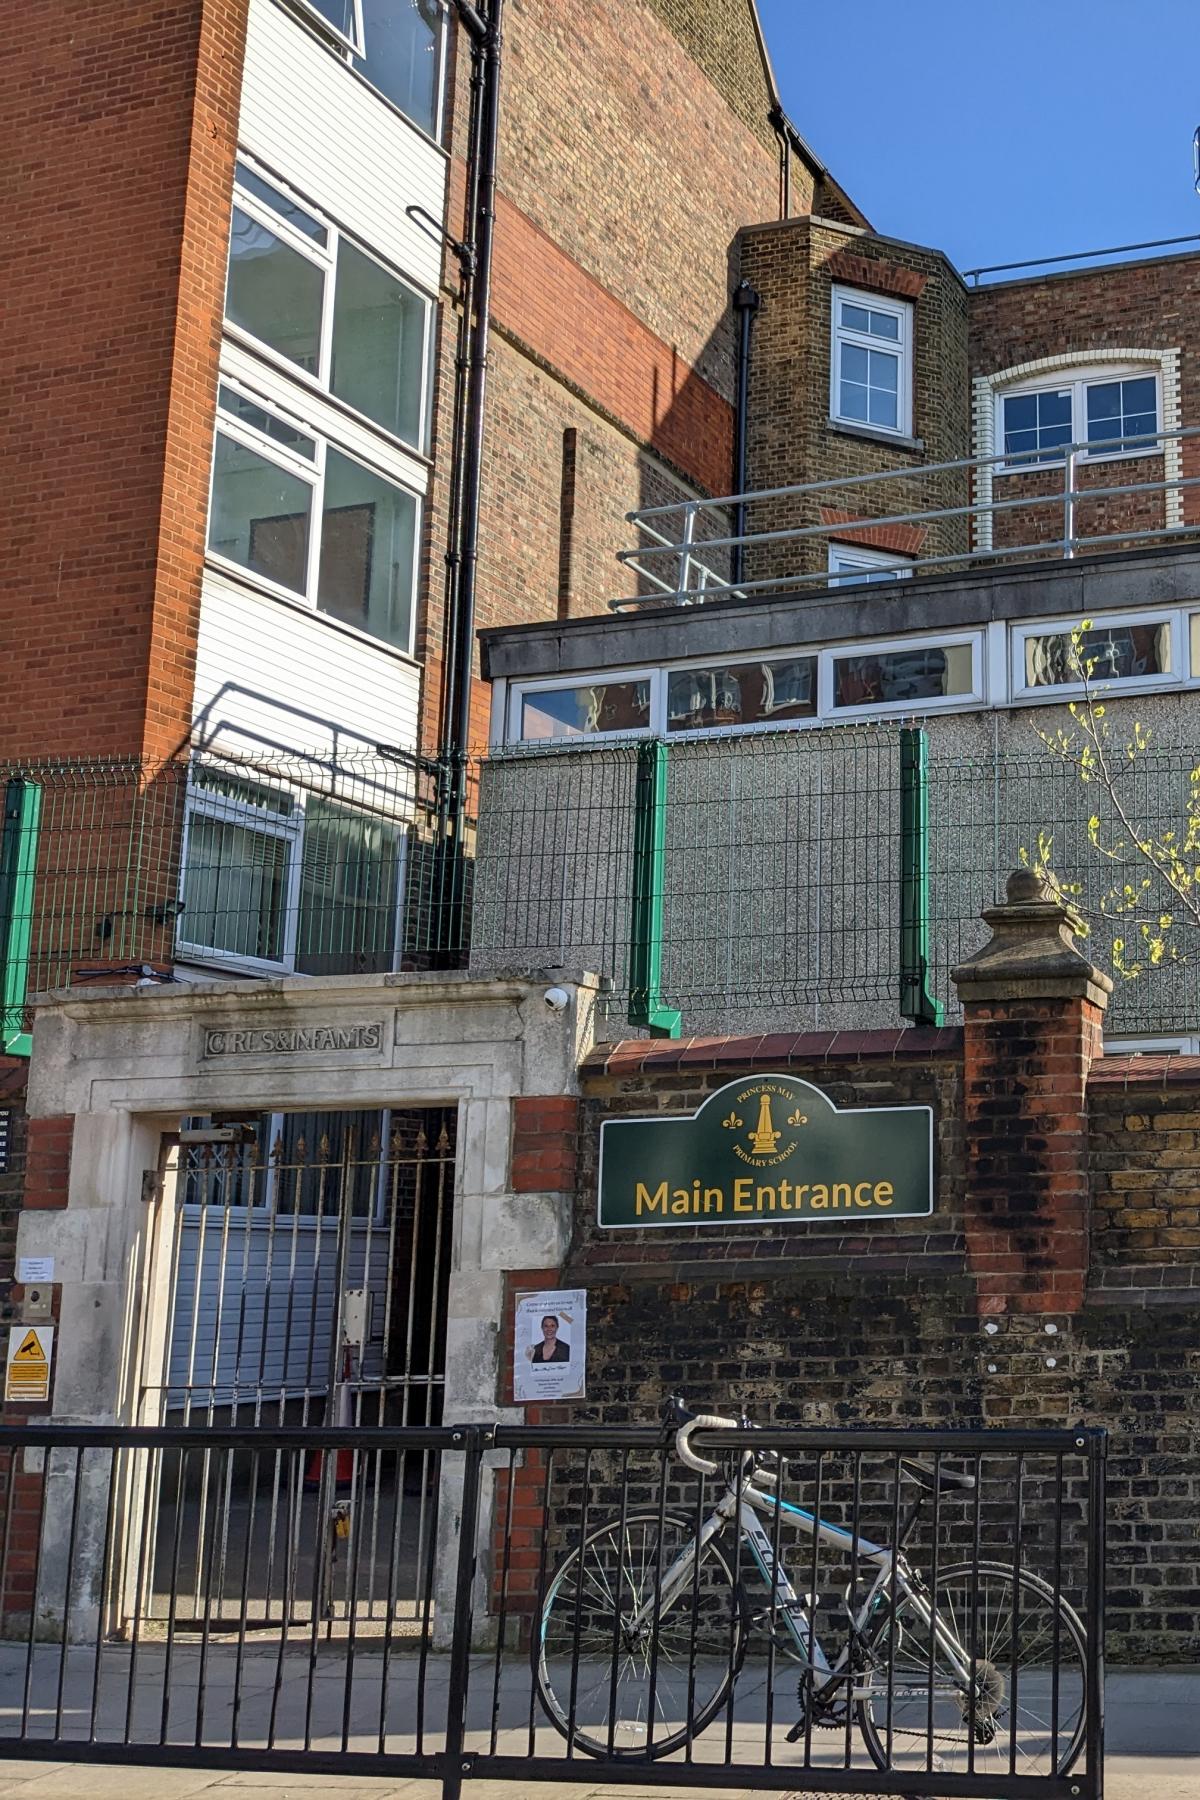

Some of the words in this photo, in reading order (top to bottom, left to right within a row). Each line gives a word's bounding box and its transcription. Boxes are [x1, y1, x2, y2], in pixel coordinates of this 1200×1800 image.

[737, 1085, 777, 1103] PRINCESS
[777, 1086, 796, 1101] MAY
[733, 1144, 767, 1168] PRIMARY
[768, 1140, 799, 1167] SCHOOL
[635, 1180, 723, 1215] Main
[734, 1177, 895, 1212] Entrance
